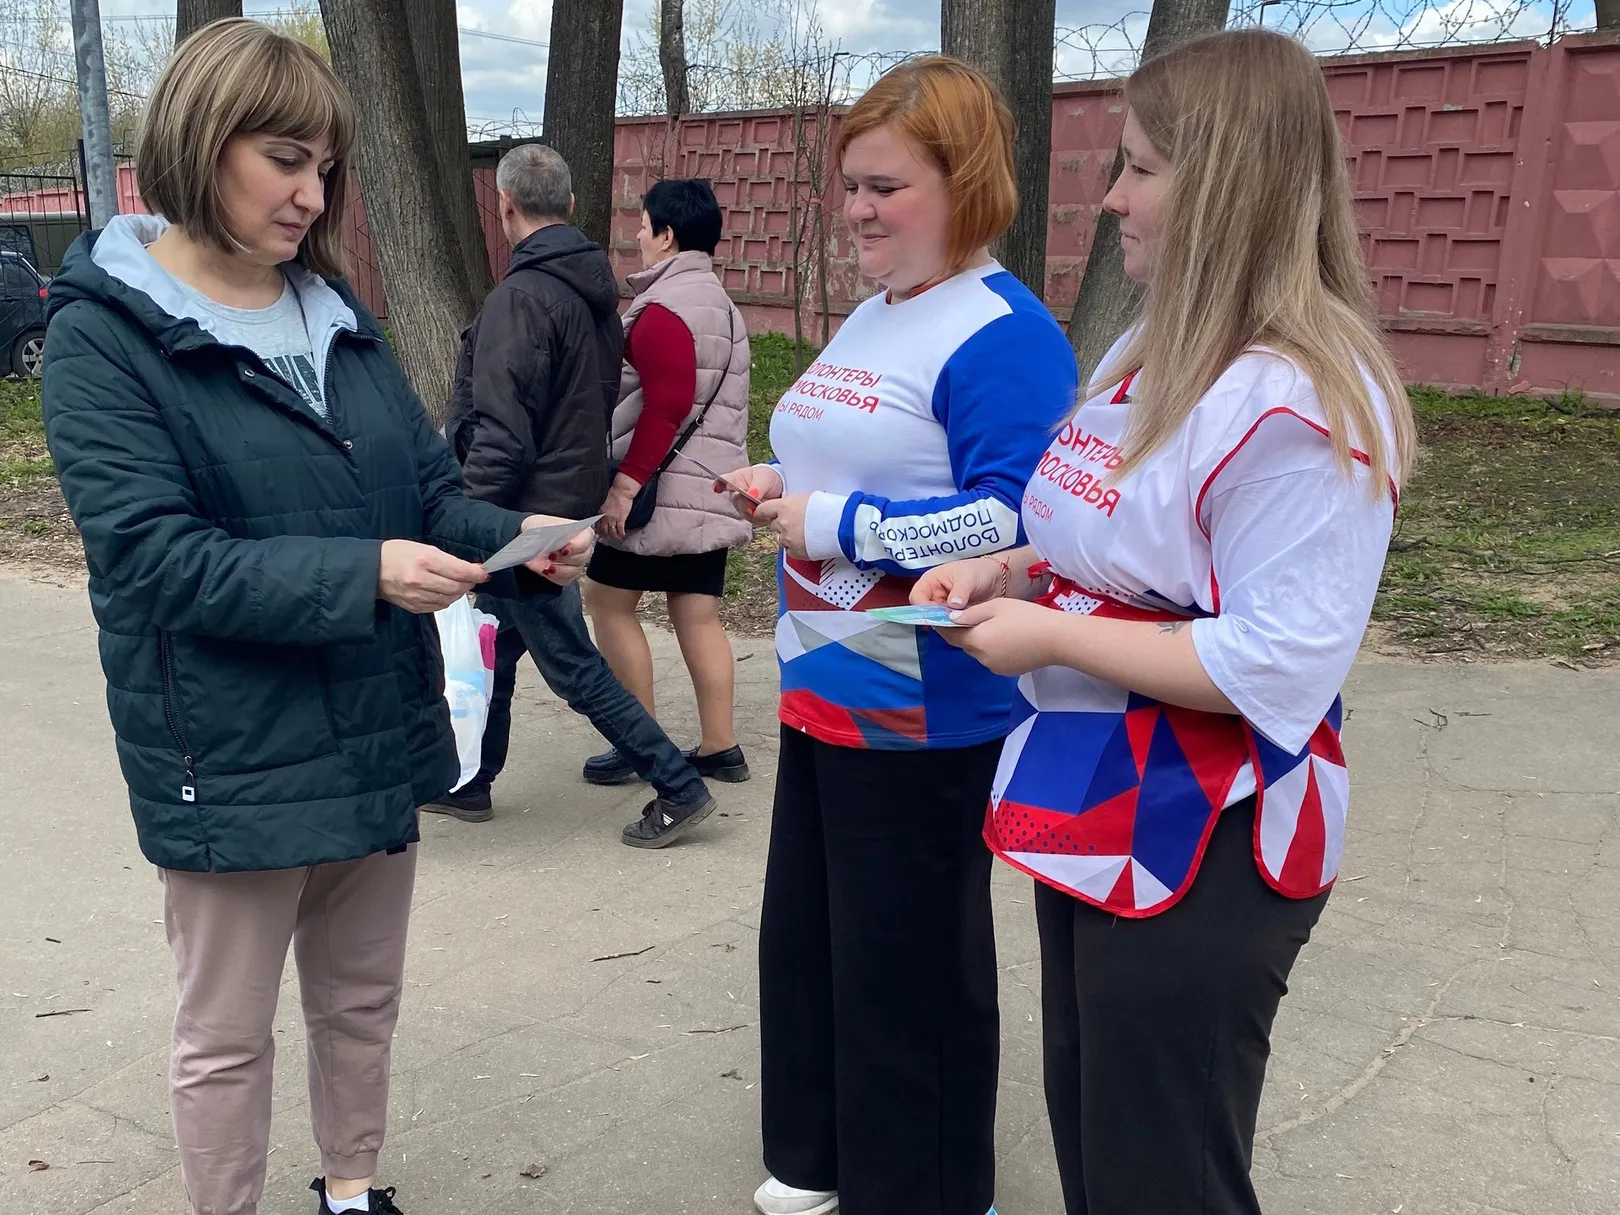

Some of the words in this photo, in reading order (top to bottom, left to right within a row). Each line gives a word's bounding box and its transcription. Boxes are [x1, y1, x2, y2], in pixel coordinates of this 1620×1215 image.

[806, 360, 882, 388] ОЛОНТЕРЫ
[789, 379, 880, 413] МОСКОВЬЯ
[788, 402, 825, 422] РЯДОМ
[1028, 494, 1055, 522] РЯДОМ
